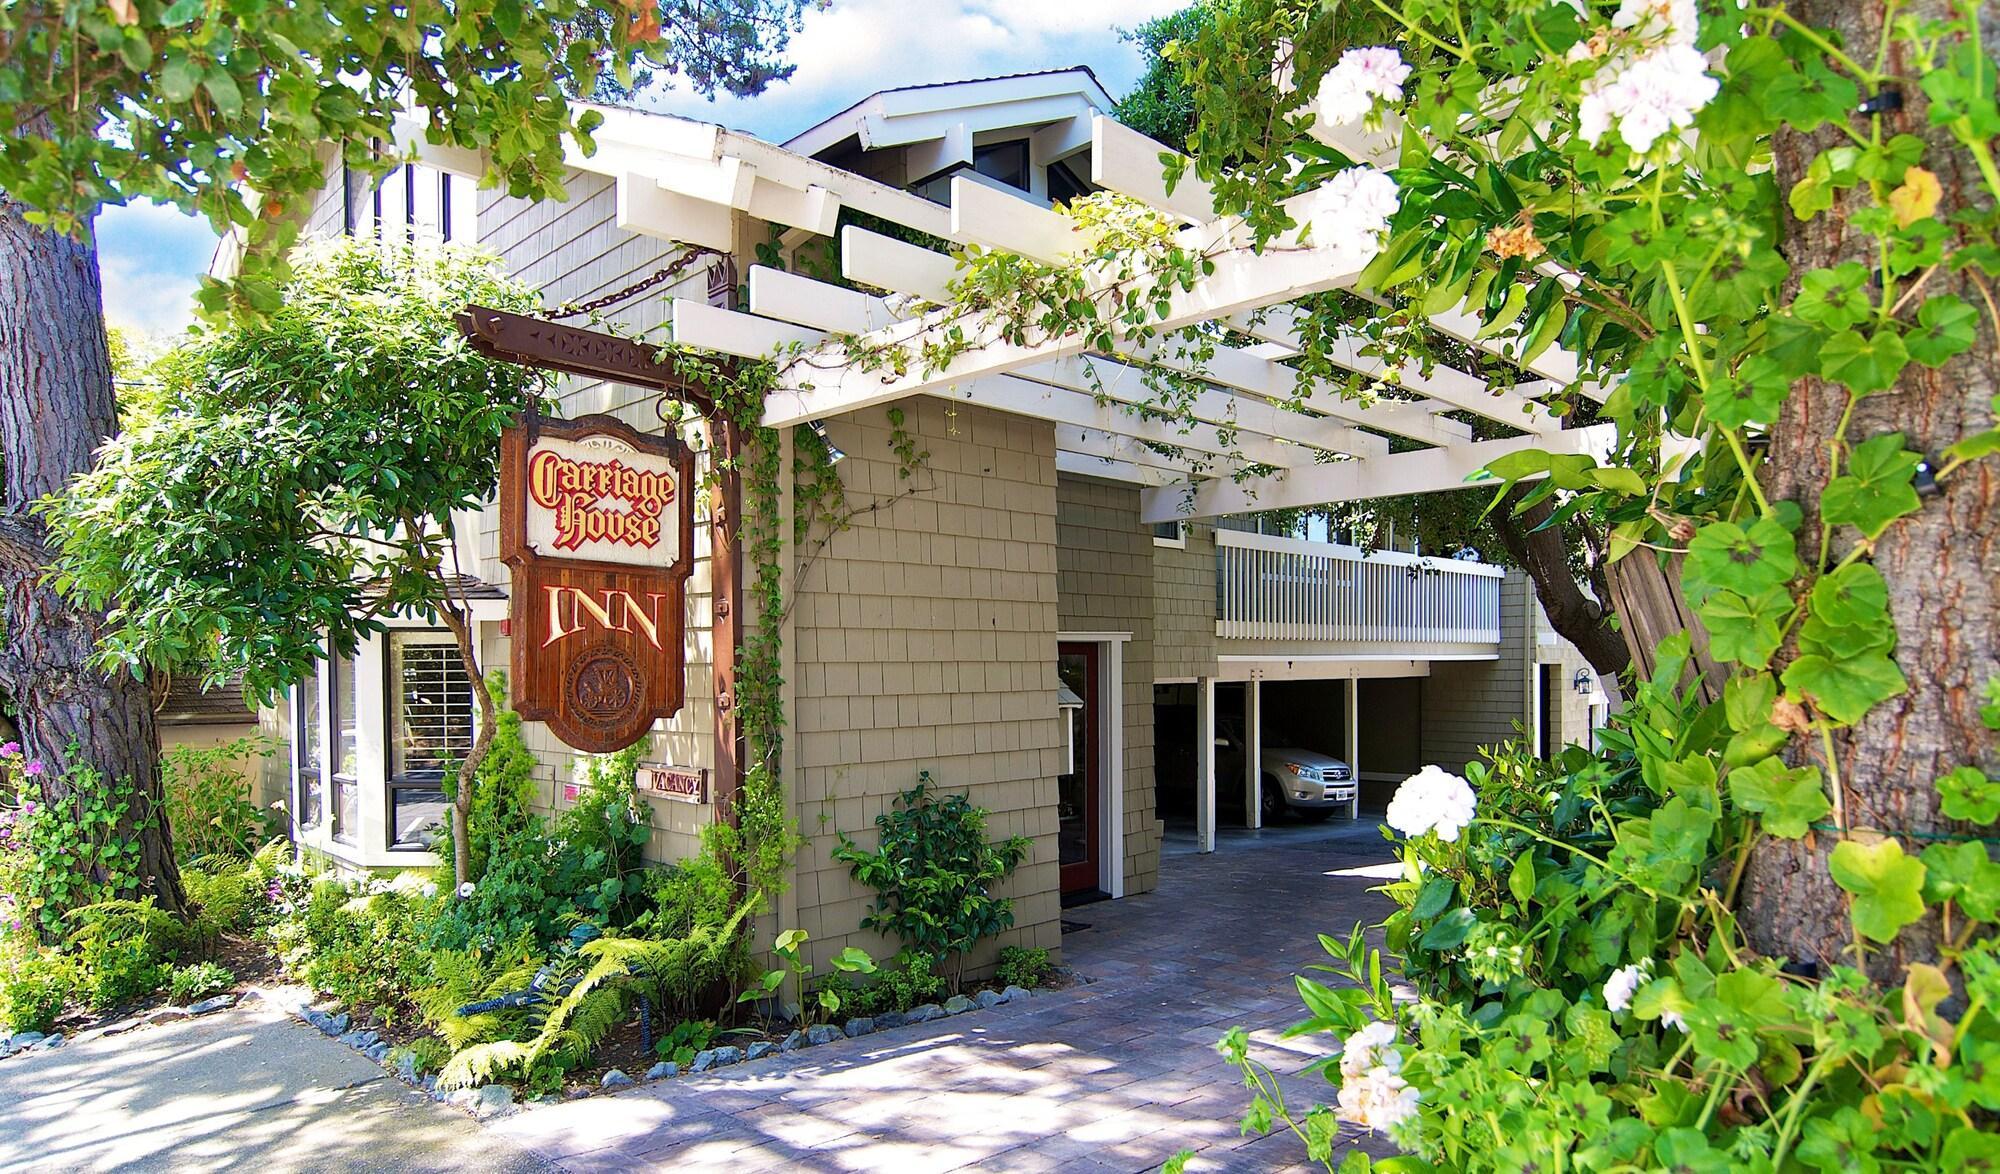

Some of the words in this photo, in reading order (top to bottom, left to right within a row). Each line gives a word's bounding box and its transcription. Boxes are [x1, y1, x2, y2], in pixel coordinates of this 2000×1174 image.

[529, 450, 675, 517] Carriage
[553, 493, 661, 551] House
[541, 586, 667, 652] INN
[651, 770, 700, 796] VACANCY
